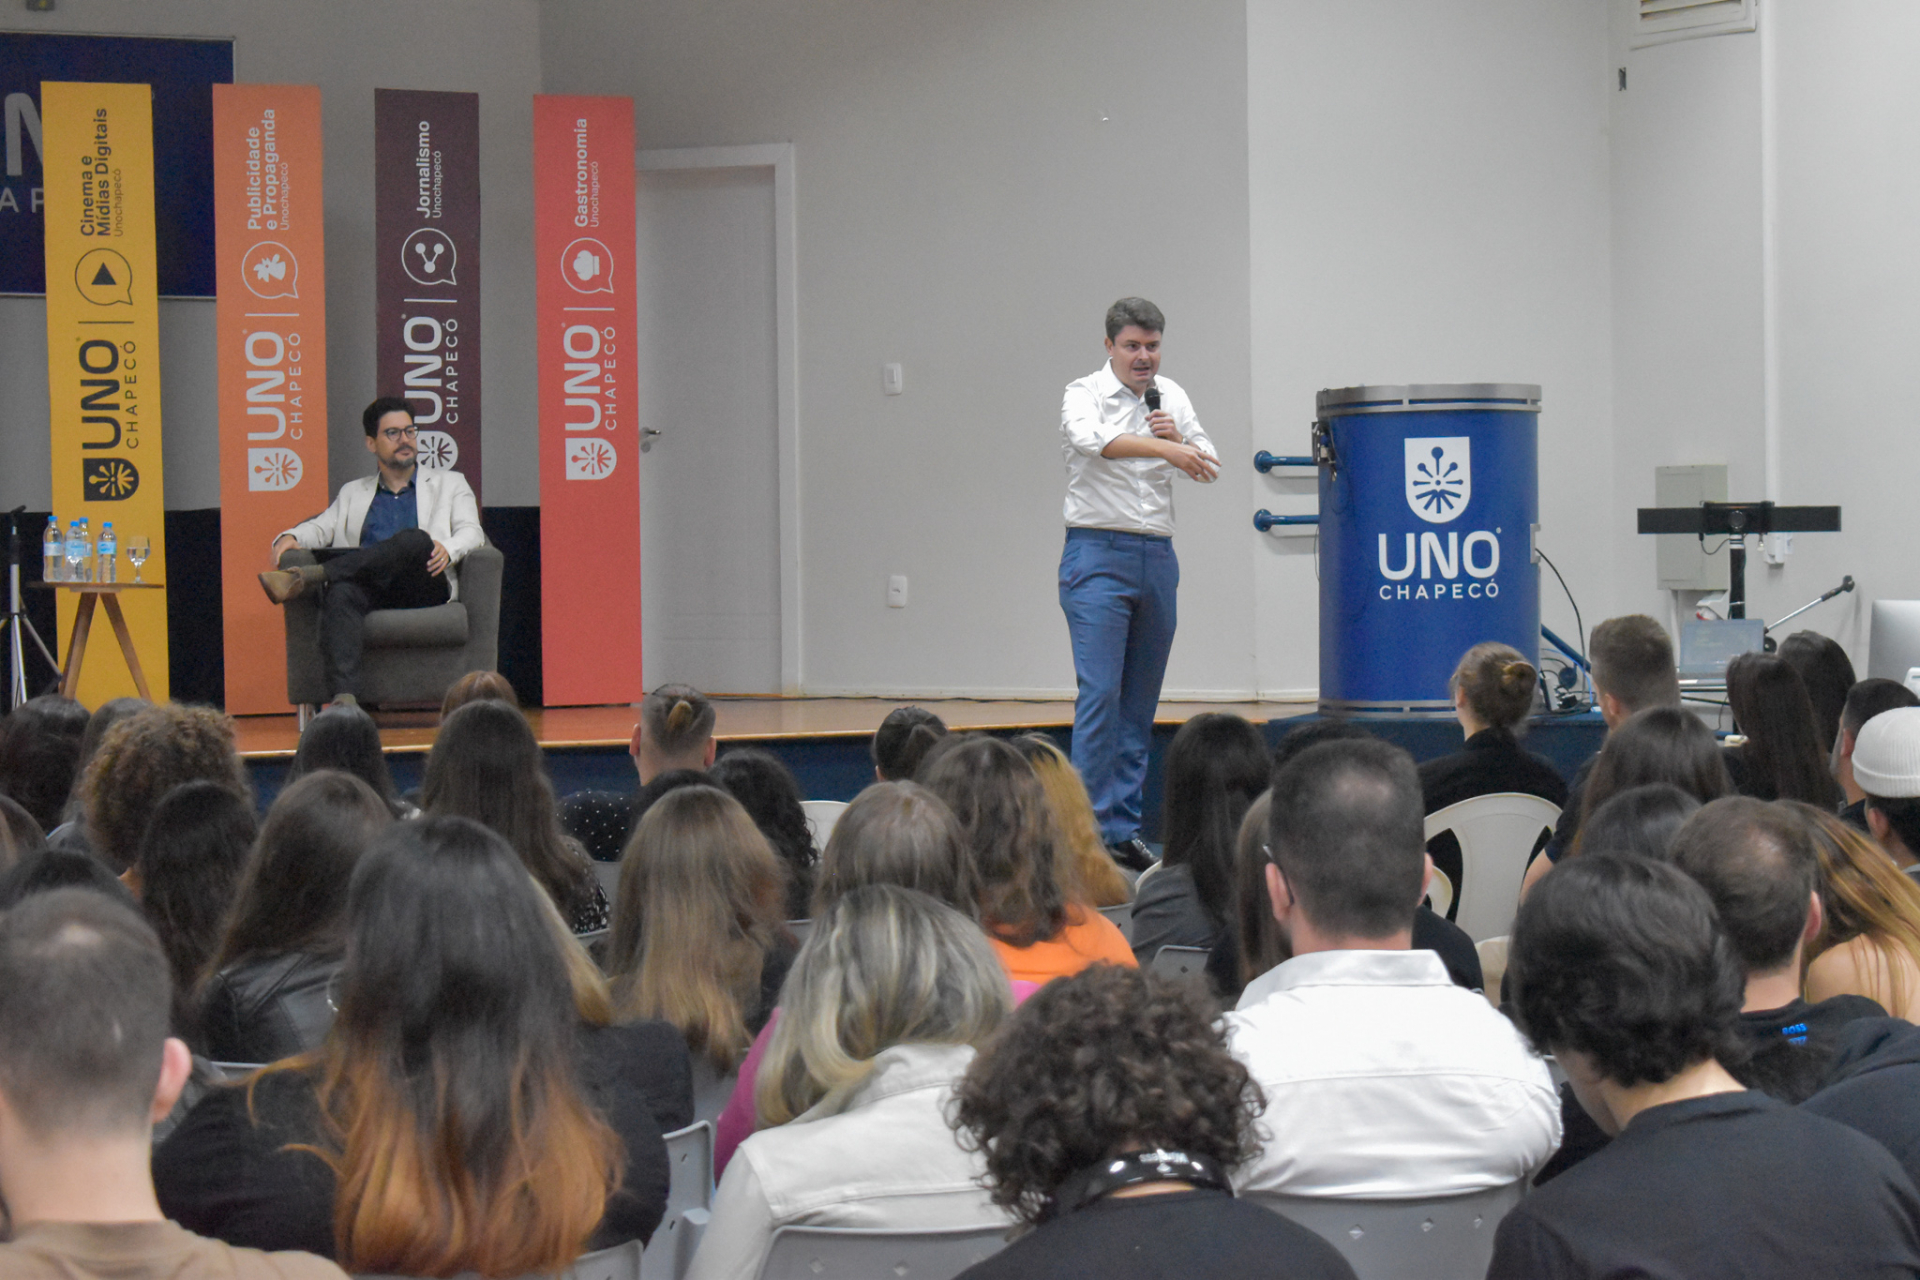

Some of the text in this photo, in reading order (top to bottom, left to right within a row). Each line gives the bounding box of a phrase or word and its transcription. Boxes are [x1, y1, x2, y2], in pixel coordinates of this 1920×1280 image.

[80, 155, 95, 236] Cinema e
[93, 108, 111, 236] Mídias Digitais
[112, 168, 124, 237] Unochapecó
[246, 127, 262, 229] Publicidade
[262, 108, 280, 230] e Propaganda
[280, 162, 290, 231] Unochapecó
[416, 121, 430, 218] Jornalismo
[432, 150, 443, 218] Unochapecó
[574, 118, 588, 227] Gastronomia
[590, 161, 600, 227] Unochapecó
[79, 339, 122, 450] UNO
[120, 341, 139, 449] CHAPECÓ
[245, 331, 286, 440] UNO
[285, 333, 303, 440] CHAPECÓ
[403, 316, 443, 424] UNO
[442, 319, 459, 424] CHAPECÓ
[563, 324, 602, 431] UNO
[601, 326, 617, 431] CHAPECÓ
[1378, 530, 1500, 581] UNO
[1379, 578, 1499, 600] CHAPECÓ
